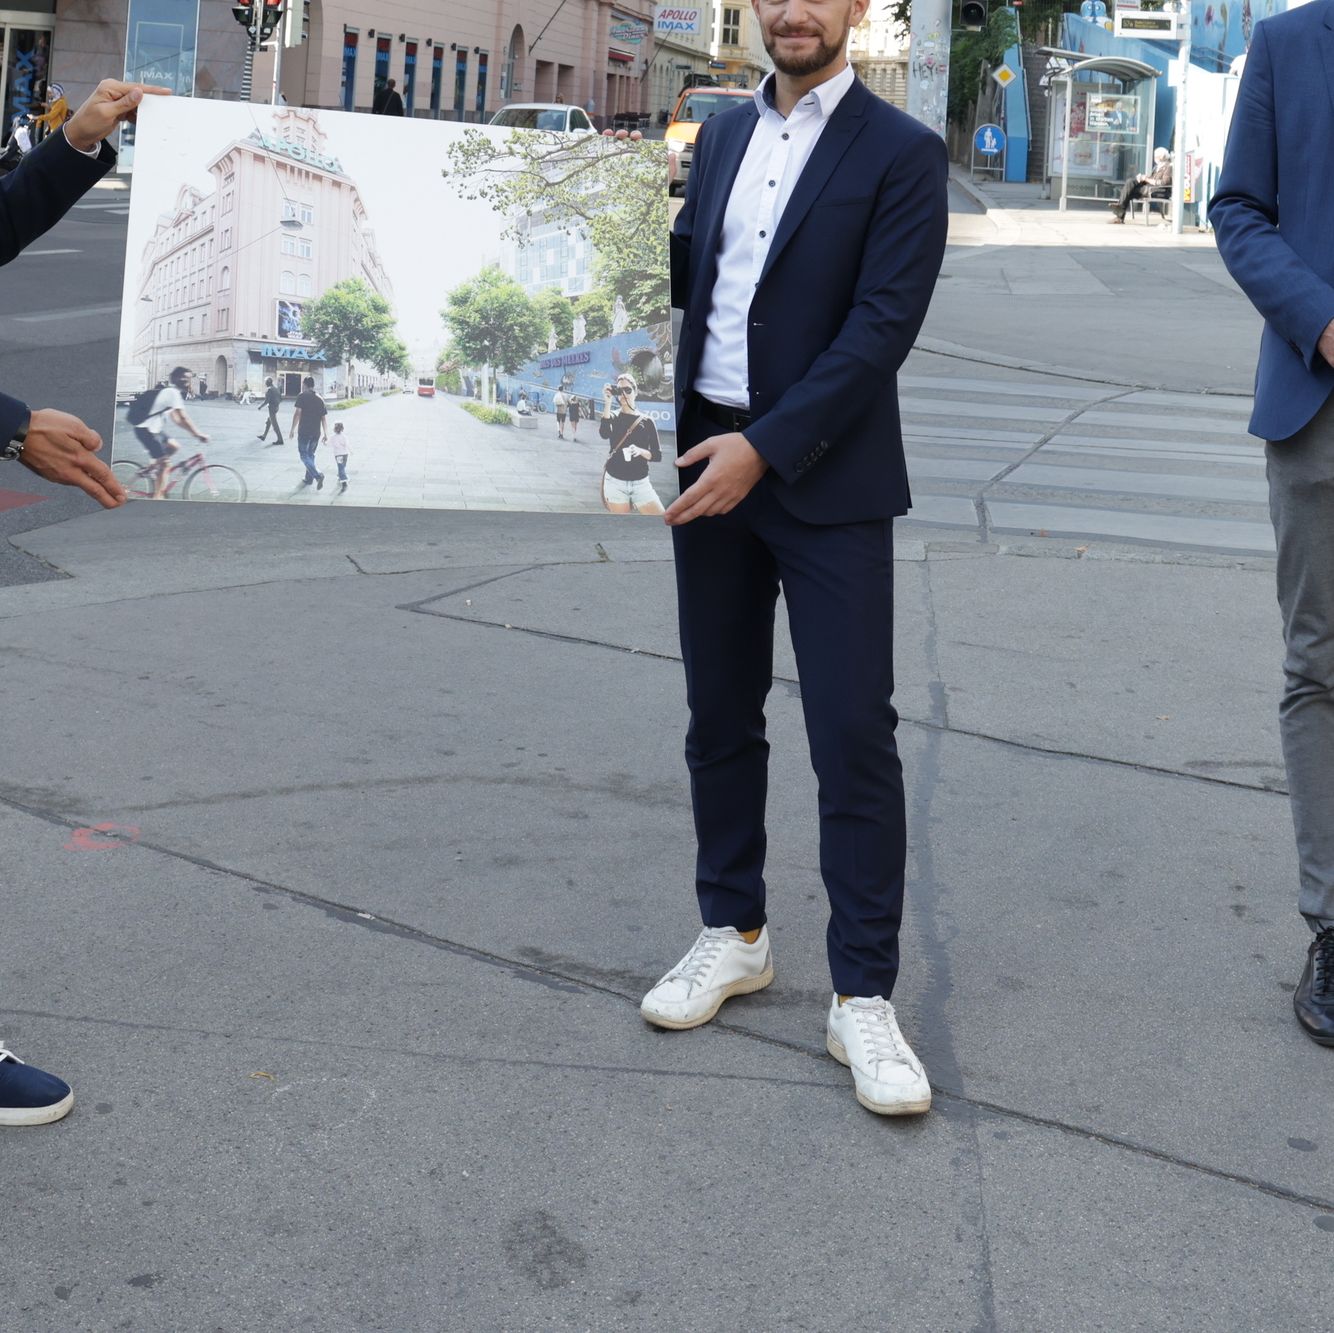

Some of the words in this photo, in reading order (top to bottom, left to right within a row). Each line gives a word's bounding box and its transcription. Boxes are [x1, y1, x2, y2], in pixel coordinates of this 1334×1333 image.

[658, 9, 698, 21] APOLLO
[657, 20, 695, 31] IMAX
[140, 70, 174, 80] IMAX
[10, 49, 35, 126] MAX
[258, 134, 338, 171] APOLLO
[261, 345, 327, 361] IMAX
